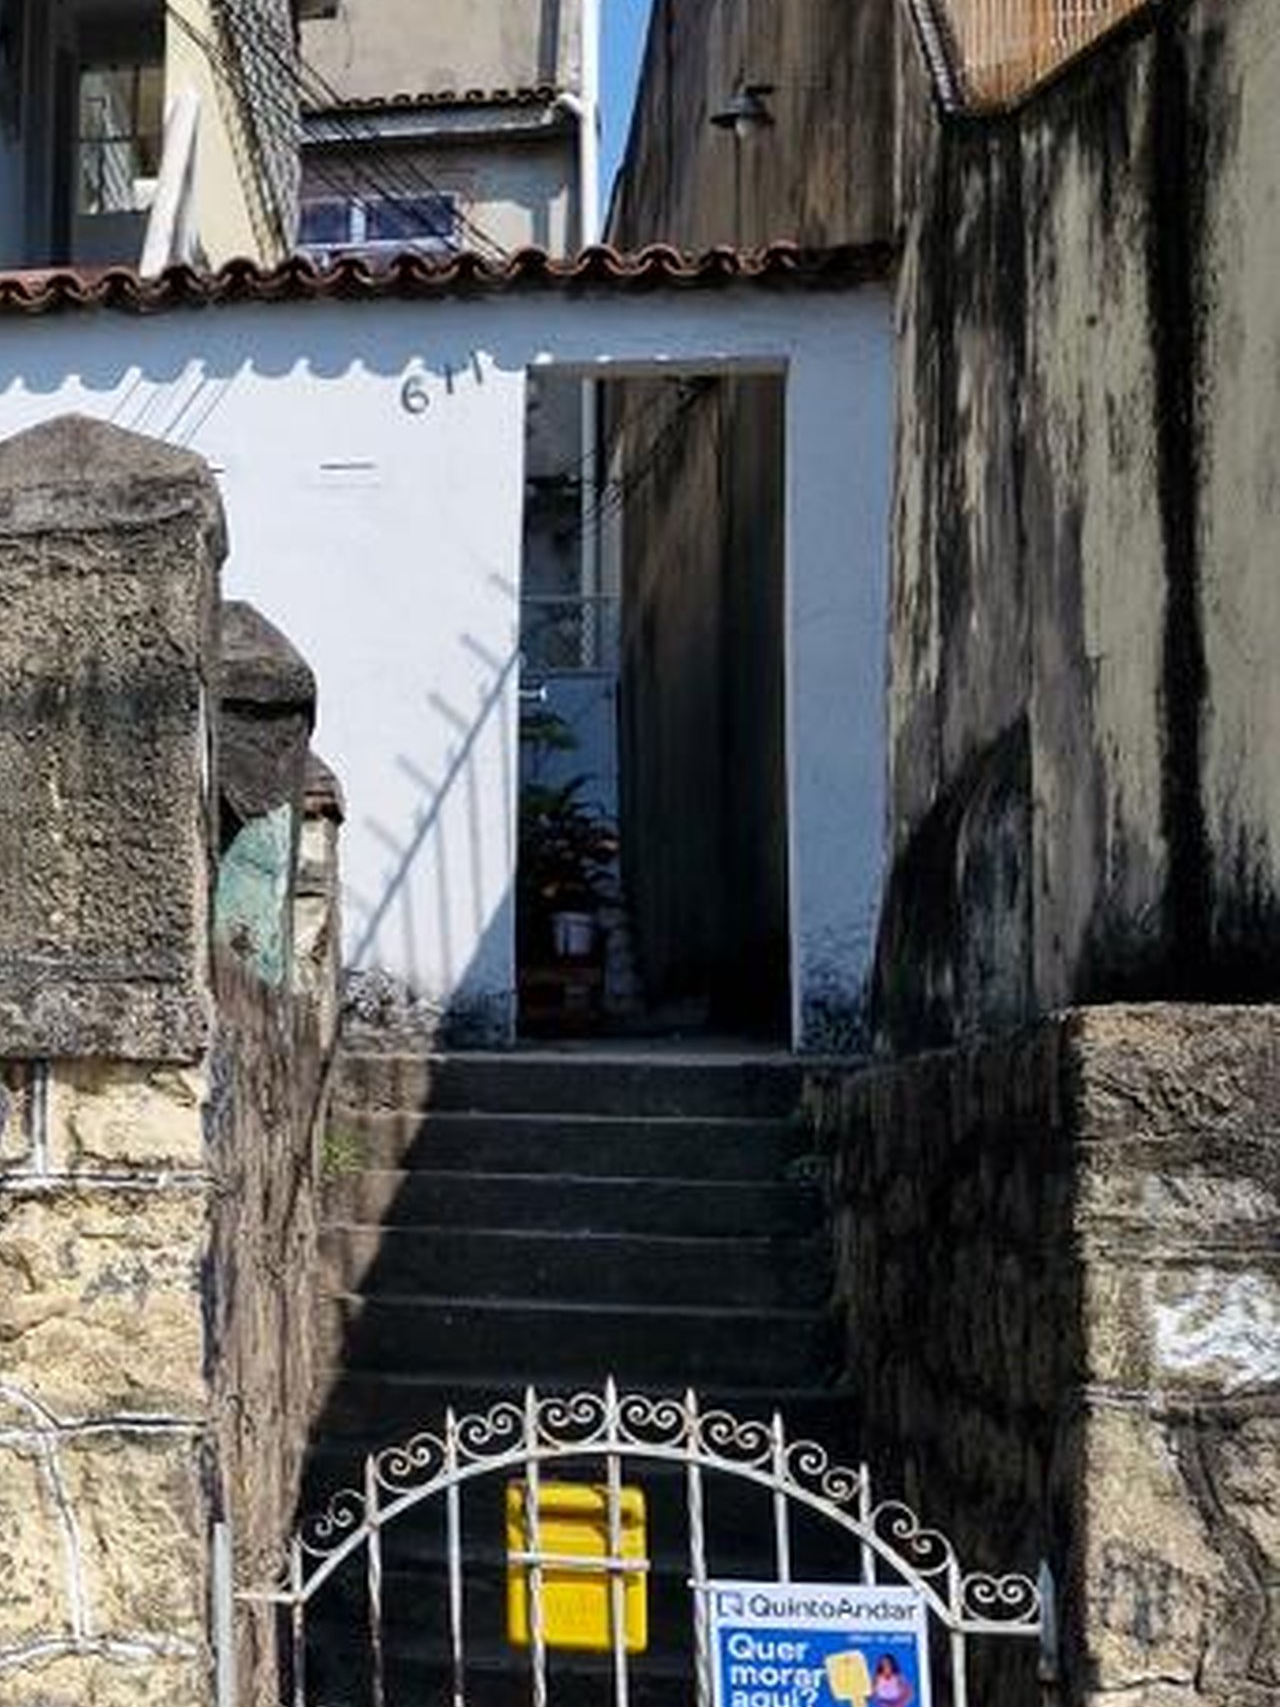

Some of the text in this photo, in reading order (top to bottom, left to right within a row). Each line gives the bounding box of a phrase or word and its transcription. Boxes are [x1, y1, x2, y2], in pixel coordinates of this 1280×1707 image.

[749, 1594, 917, 1619] QuintoAndar
[728, 1633, 810, 1661] Quer
[731, 1664, 824, 1688] morar
